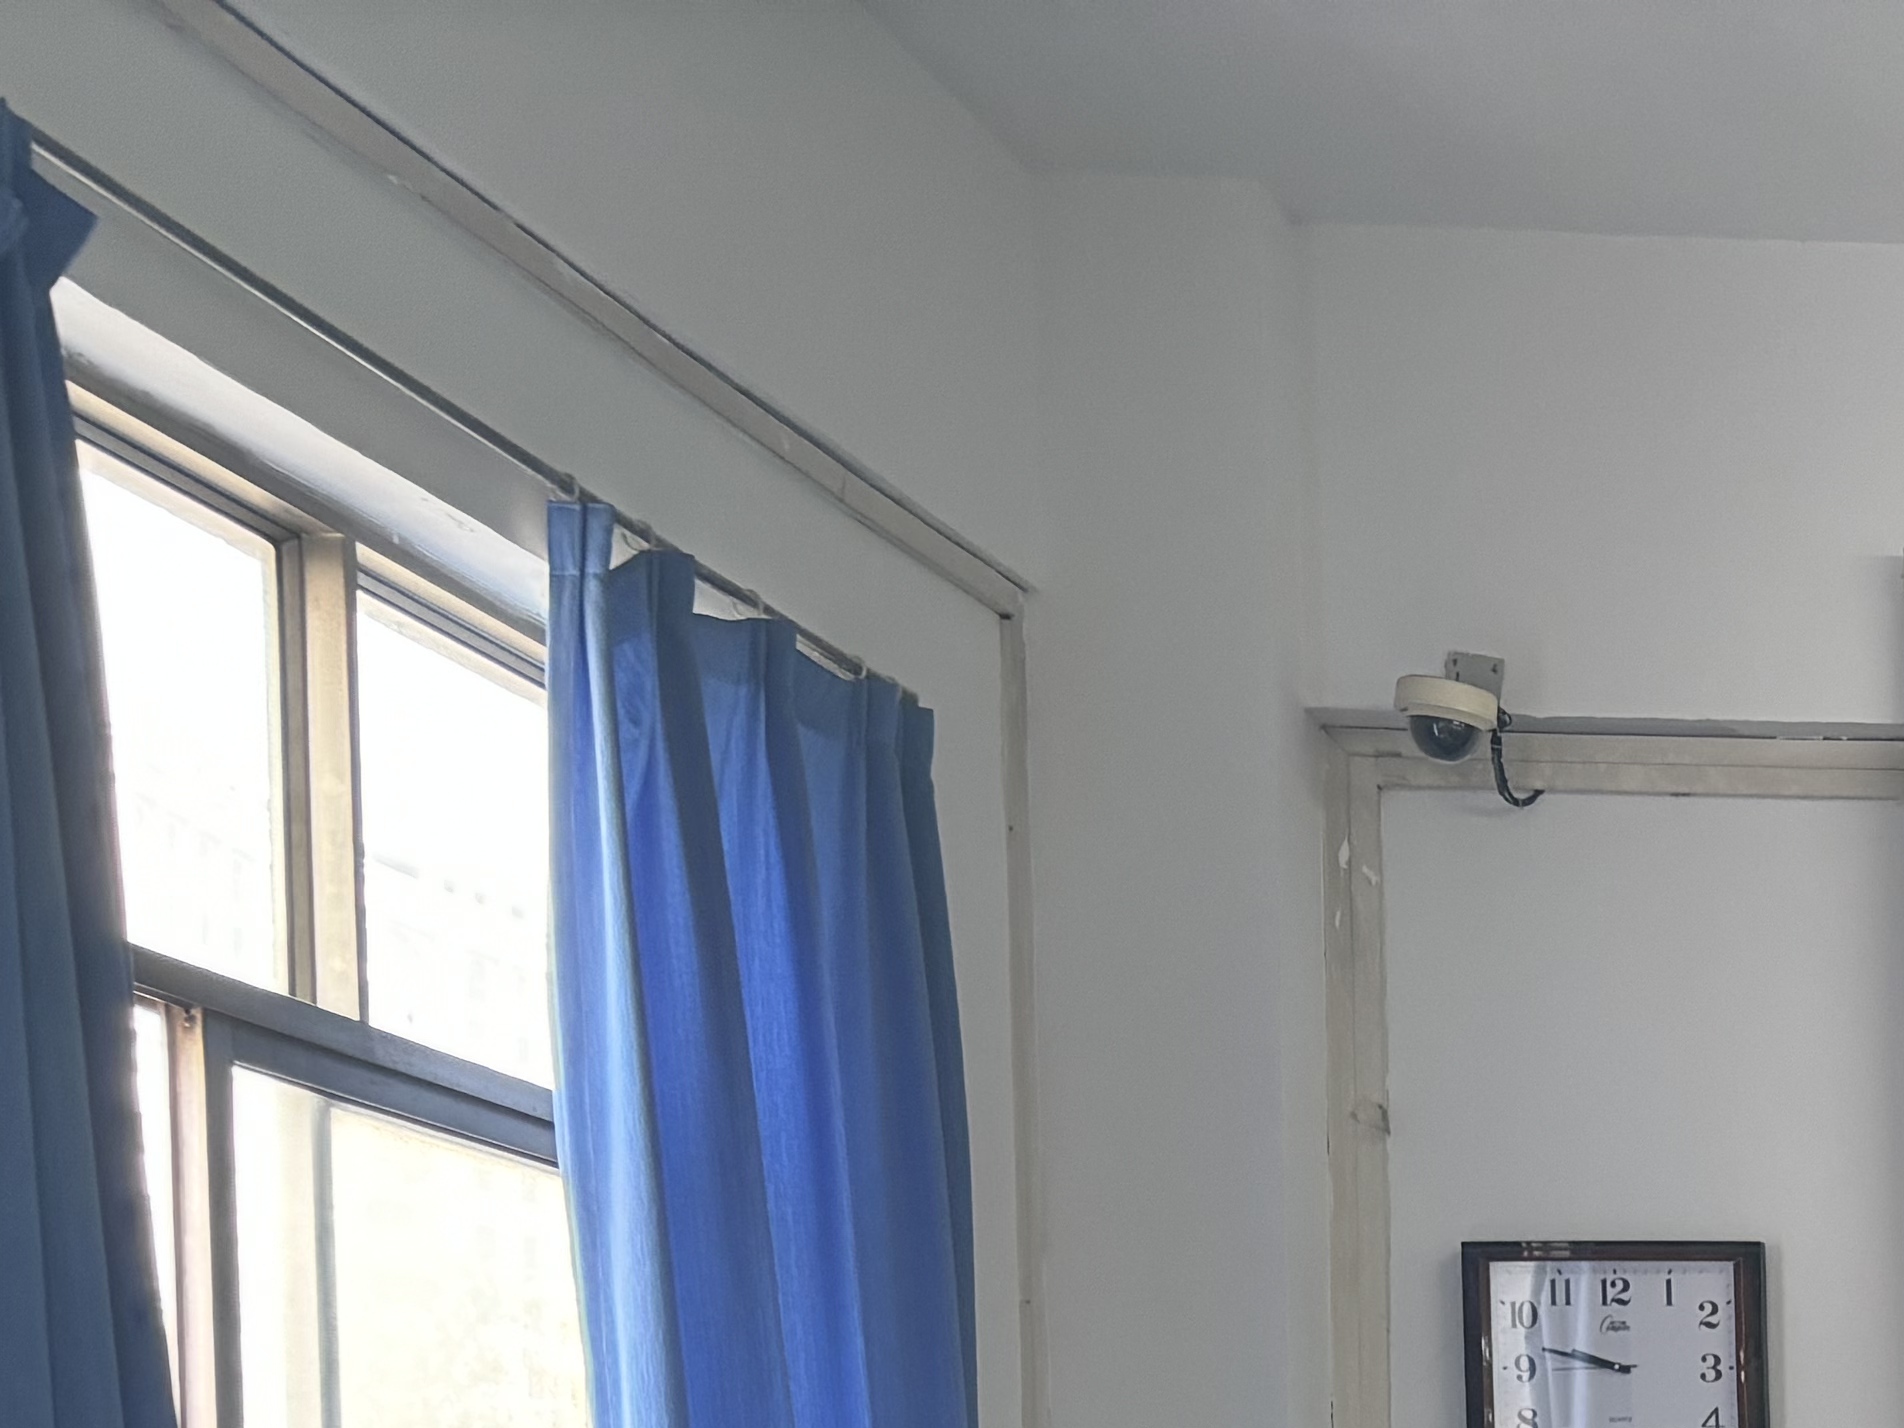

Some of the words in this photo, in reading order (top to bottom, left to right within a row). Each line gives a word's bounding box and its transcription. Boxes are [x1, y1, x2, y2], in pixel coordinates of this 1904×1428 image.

[1550, 1277, 1573, 1307] 11
[1600, 1277, 1632, 1307] 12
[1665, 1278, 1674, 1307] 1
[1510, 1300, 1539, 1329] 10
[1698, 1300, 1720, 1329] 2
[1514, 1354, 1537, 1383] 9
[1700, 1354, 1722, 1383] 3
